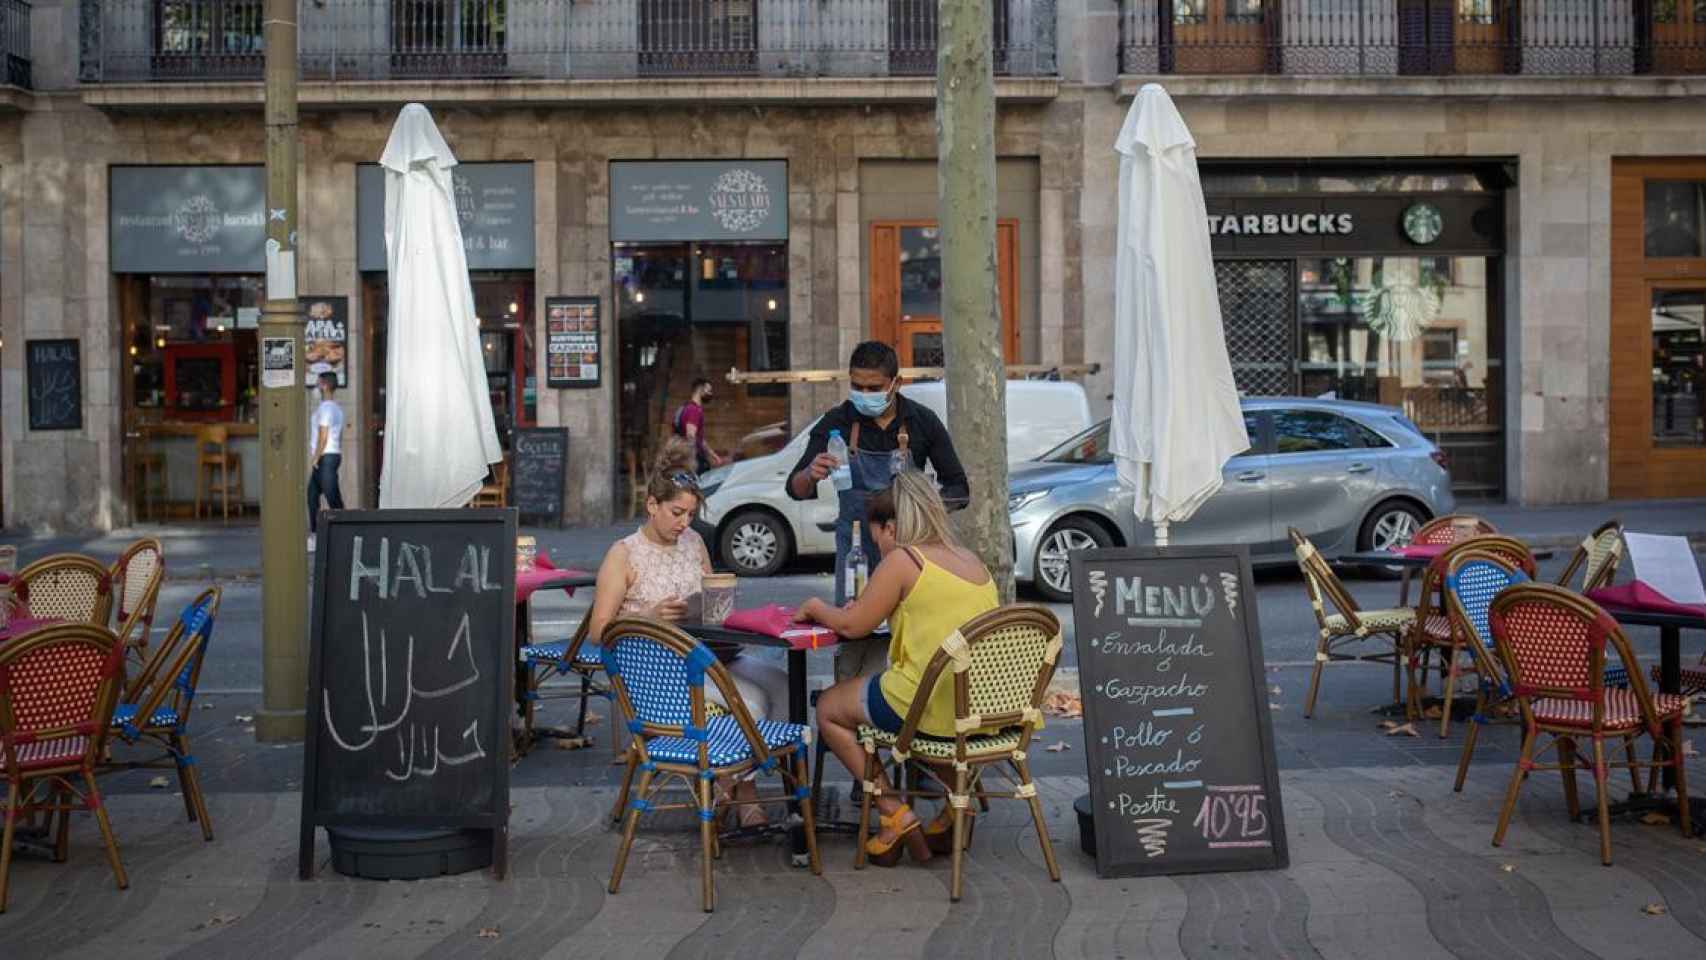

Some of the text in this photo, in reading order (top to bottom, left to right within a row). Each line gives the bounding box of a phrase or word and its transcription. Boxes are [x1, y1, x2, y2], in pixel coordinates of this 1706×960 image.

[1208, 213, 1353, 235] TARBUCKS
[349, 535, 502, 601] HALAL
[1101, 628, 1214, 657] Ensalada
[1104, 674, 1209, 704] Gazpacho
[1113, 721, 1172, 748] Pollo
[1115, 749, 1202, 778] Pescado
[1118, 786, 1181, 816] Postre
